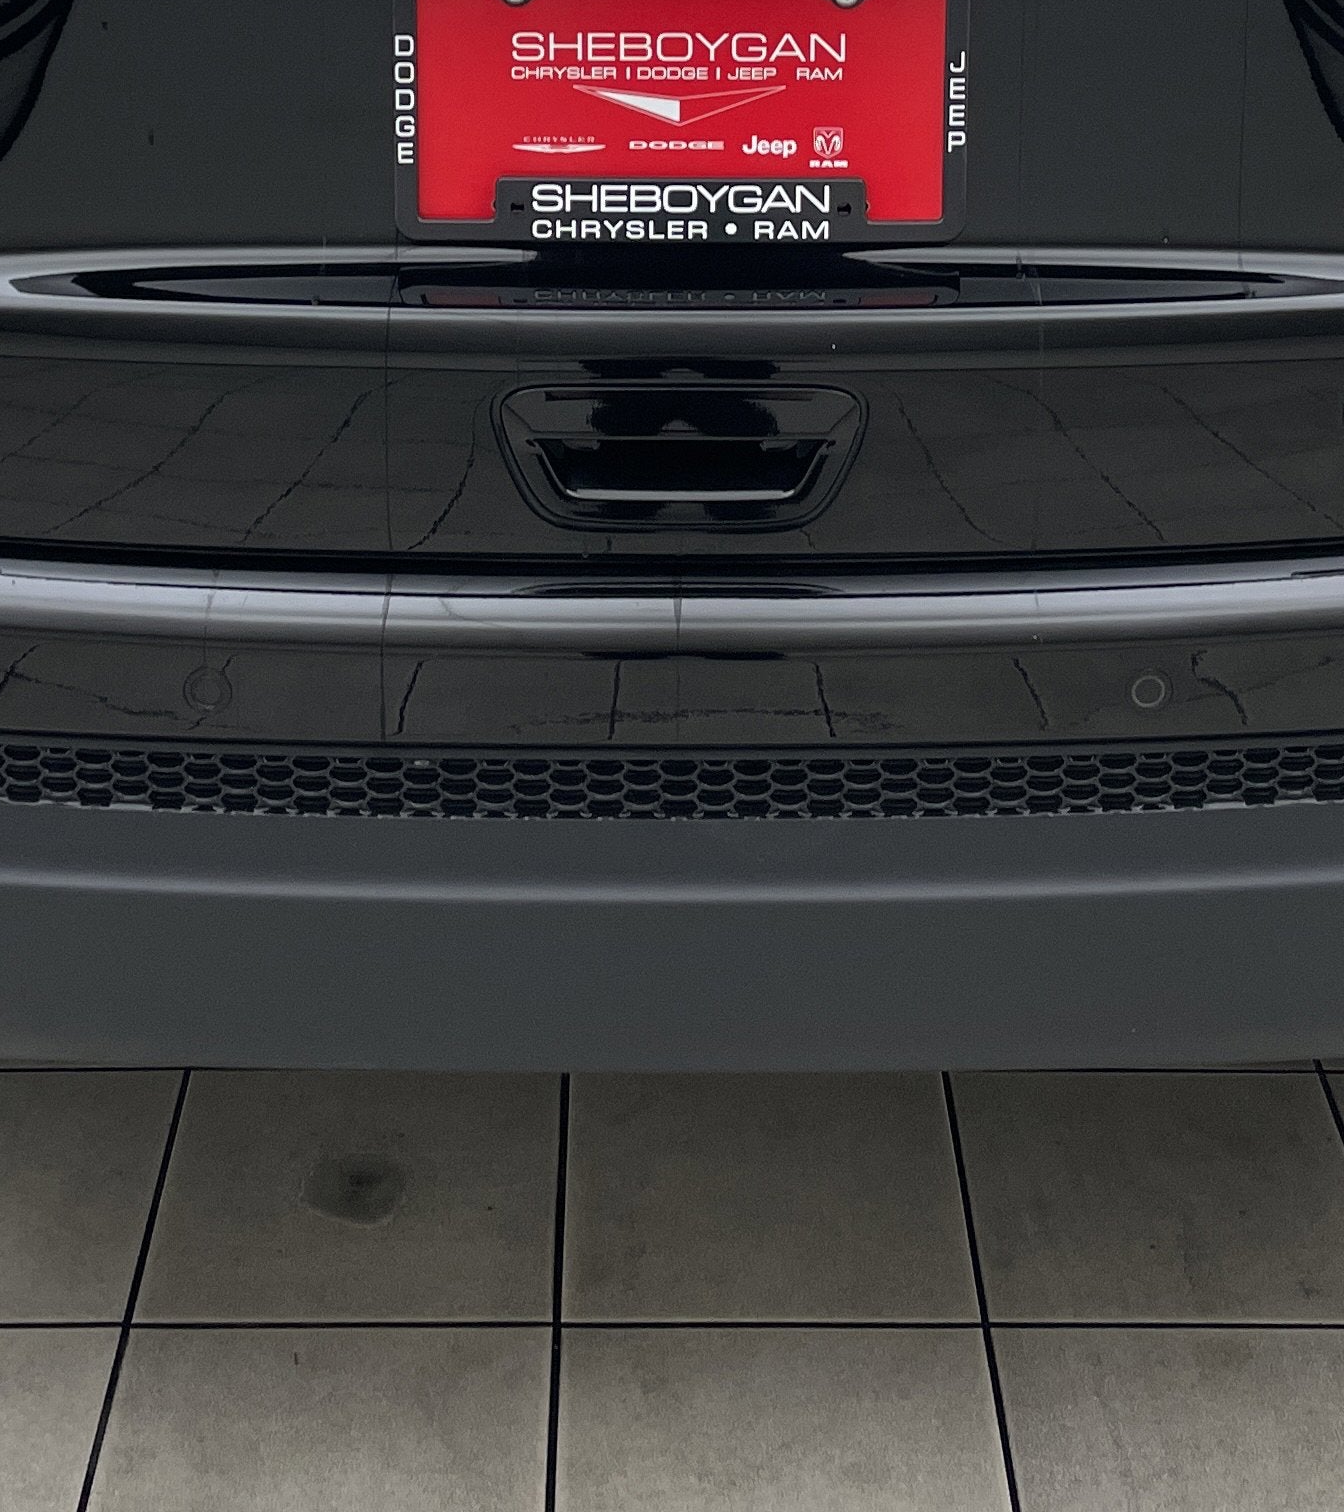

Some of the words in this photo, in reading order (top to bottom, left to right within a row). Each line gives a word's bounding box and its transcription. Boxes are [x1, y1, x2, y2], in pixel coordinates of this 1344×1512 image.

[511, 31, 846, 63] SHEBOYGAN
[511, 66, 617, 81] CHRYSLER
[637, 66, 709, 81] DODGE
[727, 66, 778, 81] JEEP
[796, 66, 844, 81] RAM
[393, 34, 416, 165] DODGE
[947, 50, 966, 153] JEEP
[628, 140, 725, 151] DODGE
[742, 134, 798, 159] Jeep
[809, 159, 849, 169] RAM
[531, 183, 831, 214] SHEBOYGAN
[531, 219, 708, 240] CHRYSLER
[754, 220, 830, 240] RAM
